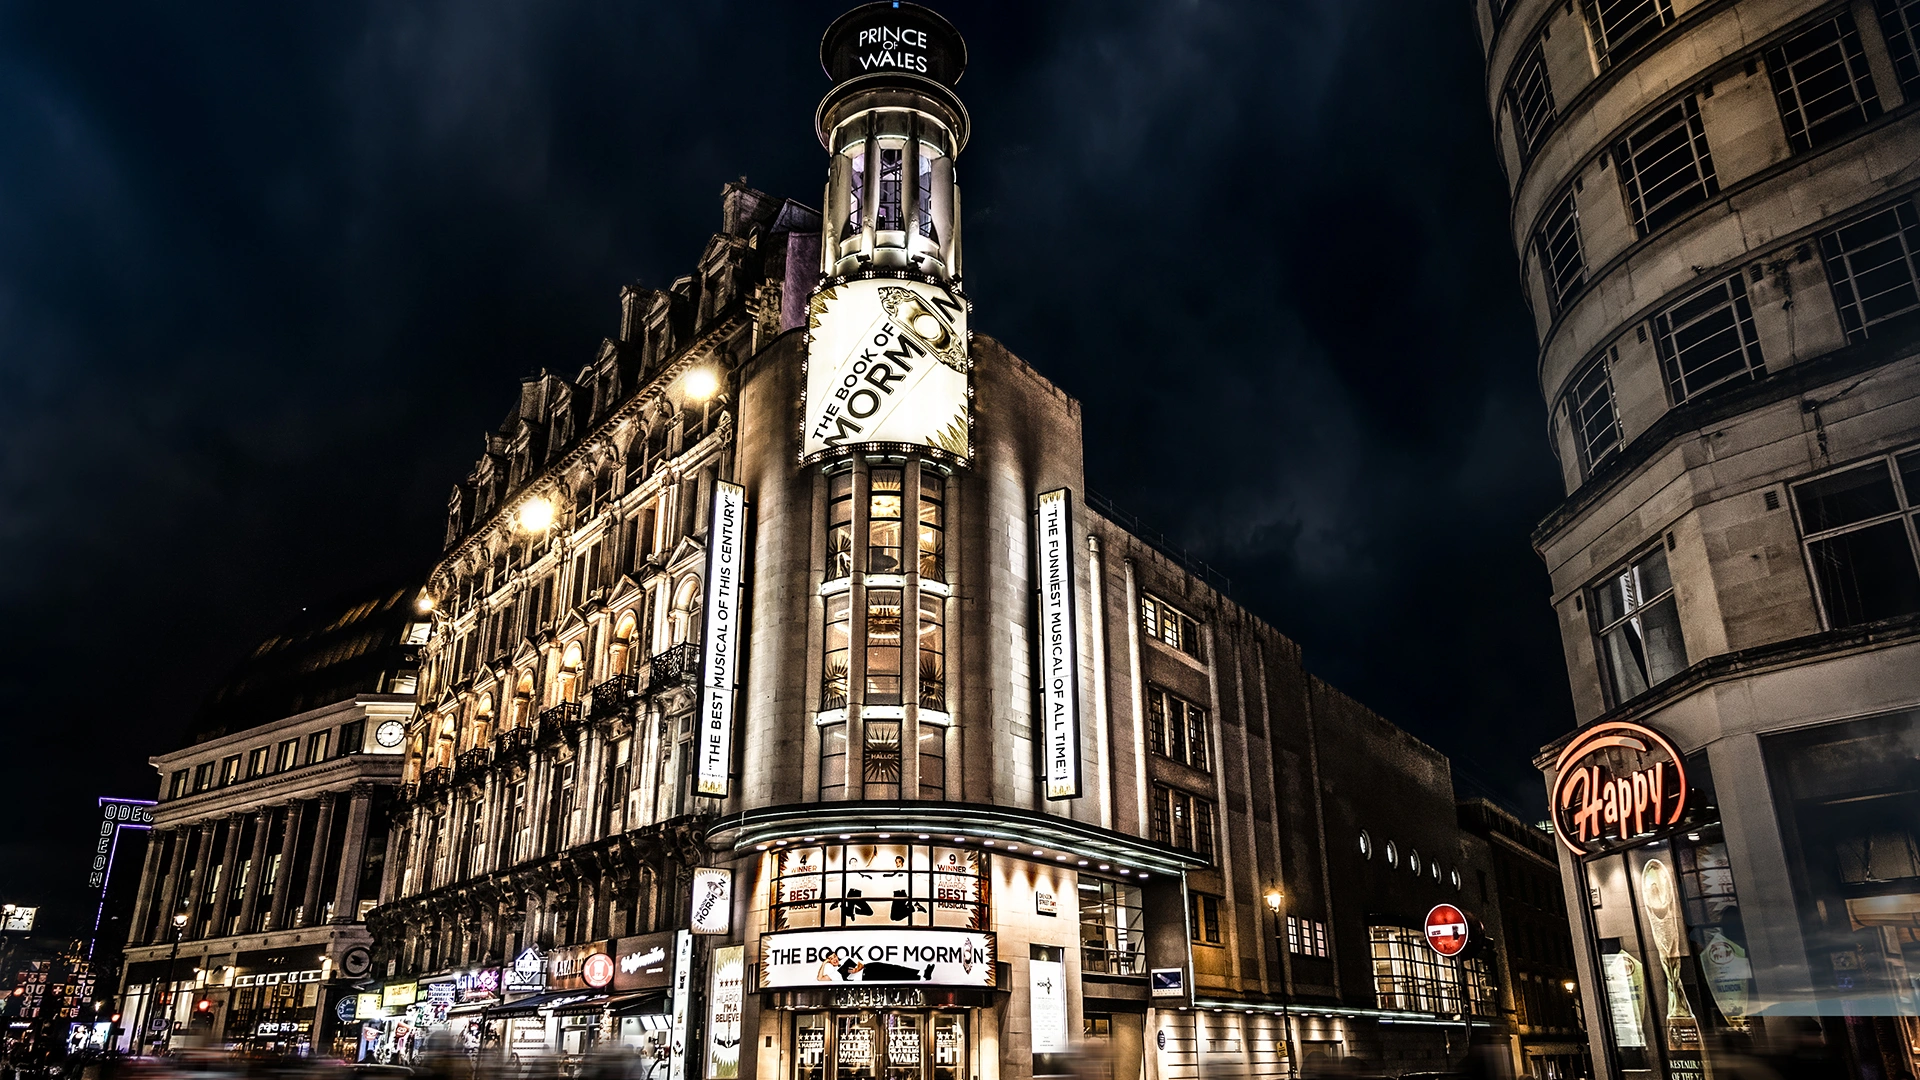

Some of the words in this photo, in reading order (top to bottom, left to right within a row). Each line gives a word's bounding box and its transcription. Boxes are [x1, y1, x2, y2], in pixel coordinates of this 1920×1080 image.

[859, 26, 927, 49] PRINCE
[883, 41, 898, 50] OF
[859, 51, 927, 73] WALES
[812, 403, 840, 440] THE
[835, 348, 879, 401] BOOK
[873, 322, 895, 347] OF
[719, 567, 731, 597] THIS
[1048, 540, 1061, 608] FUNNIEST
[718, 600, 729, 621] OF
[1051, 612, 1063, 676] MUSICAL
[714, 624, 728, 688] MUSICAL
[1053, 678, 1064, 698] OF
[711, 692, 723, 730] BEST
[1054, 702, 1065, 731] ALL
[1562, 762, 1663, 842] Happy
[791, 865, 818, 873] WINNER
[799, 854, 807, 866] 4
[937, 864, 967, 873] WINNER
[949, 854, 957, 865] 9
[790, 888, 818, 901] BEST
[938, 888, 968, 901] BEST
[772, 948, 801, 966] THE
[805, 946, 864, 963] BOOK
[868, 946, 898, 962] OF
[903, 944, 984, 965] MORMON
[723, 1004, 732, 1012] I'M
[733, 1003, 737, 1012] A
[839, 1042, 871, 1051] KILLER
[936, 1047, 964, 1064] HIT
